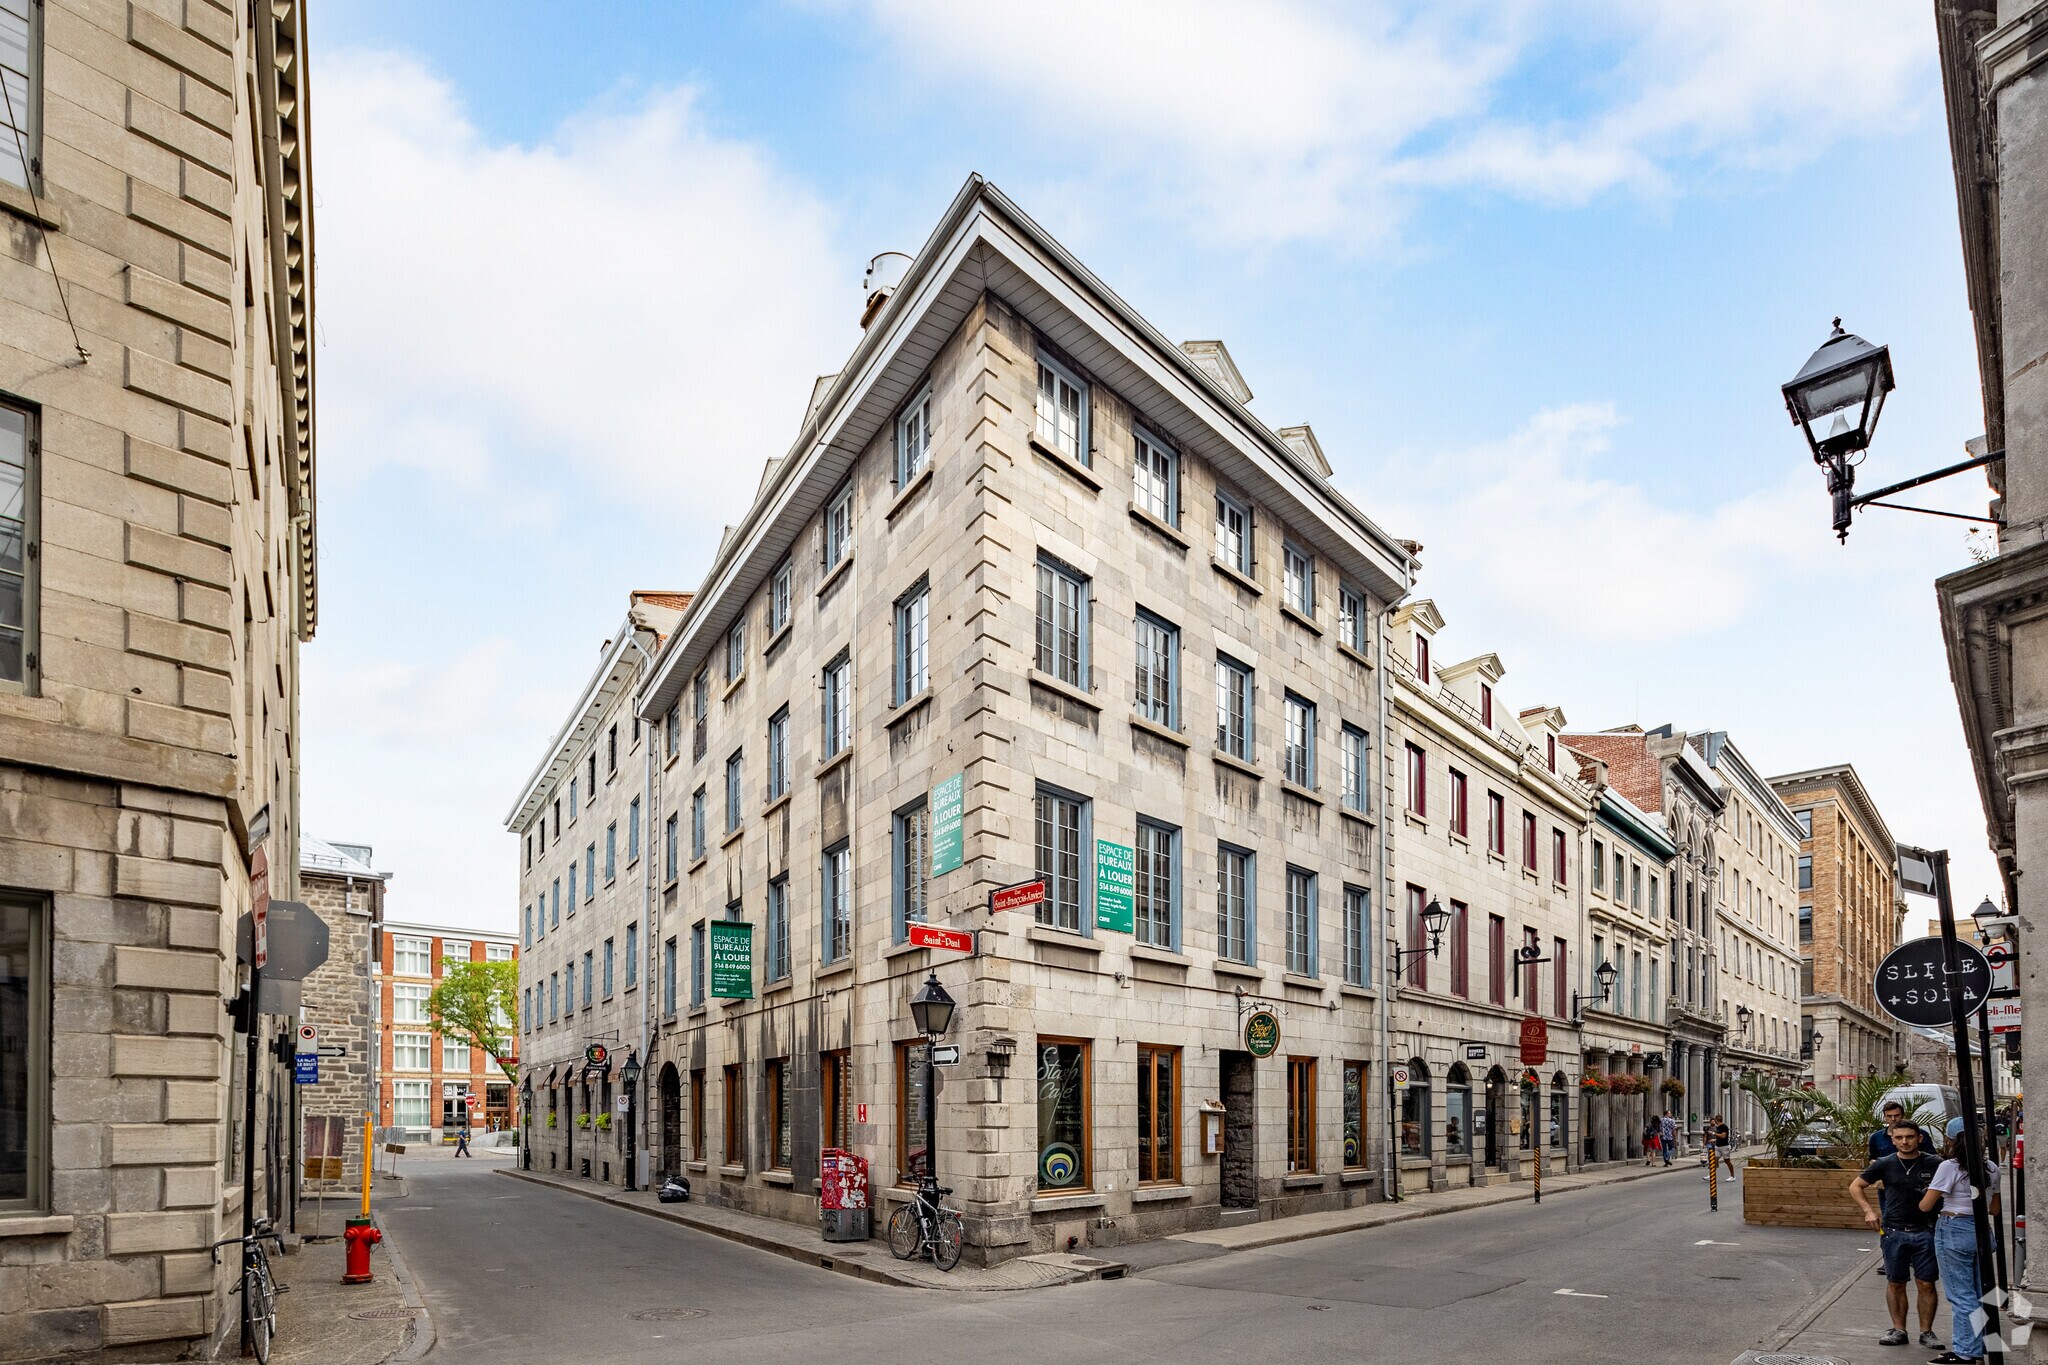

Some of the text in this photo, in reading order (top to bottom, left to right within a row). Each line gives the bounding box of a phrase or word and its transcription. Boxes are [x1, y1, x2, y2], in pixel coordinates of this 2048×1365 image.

[934, 776, 961, 800] ESPACE DE
[934, 789, 961, 811] BUREAUX
[934, 803, 961, 826] À LOUER
[941, 823, 950, 835] 849
[949, 819, 961, 831] 6000
[1099, 843, 1132, 861] ESPACE DE
[1099, 854, 1132, 871] BUREAUX
[1099, 865, 1132, 885] À LOUER
[1099, 882, 1132, 897] 514 849 6000
[713, 935, 739, 944] ESPACE
[713, 943, 750, 952] BUREAUX
[923, 934, 960, 948] Saint-Paul
[714, 951, 750, 962] À LOUER
[1886, 958, 1978, 980] SLIE
[1037, 1046, 1081, 1081] Stash
